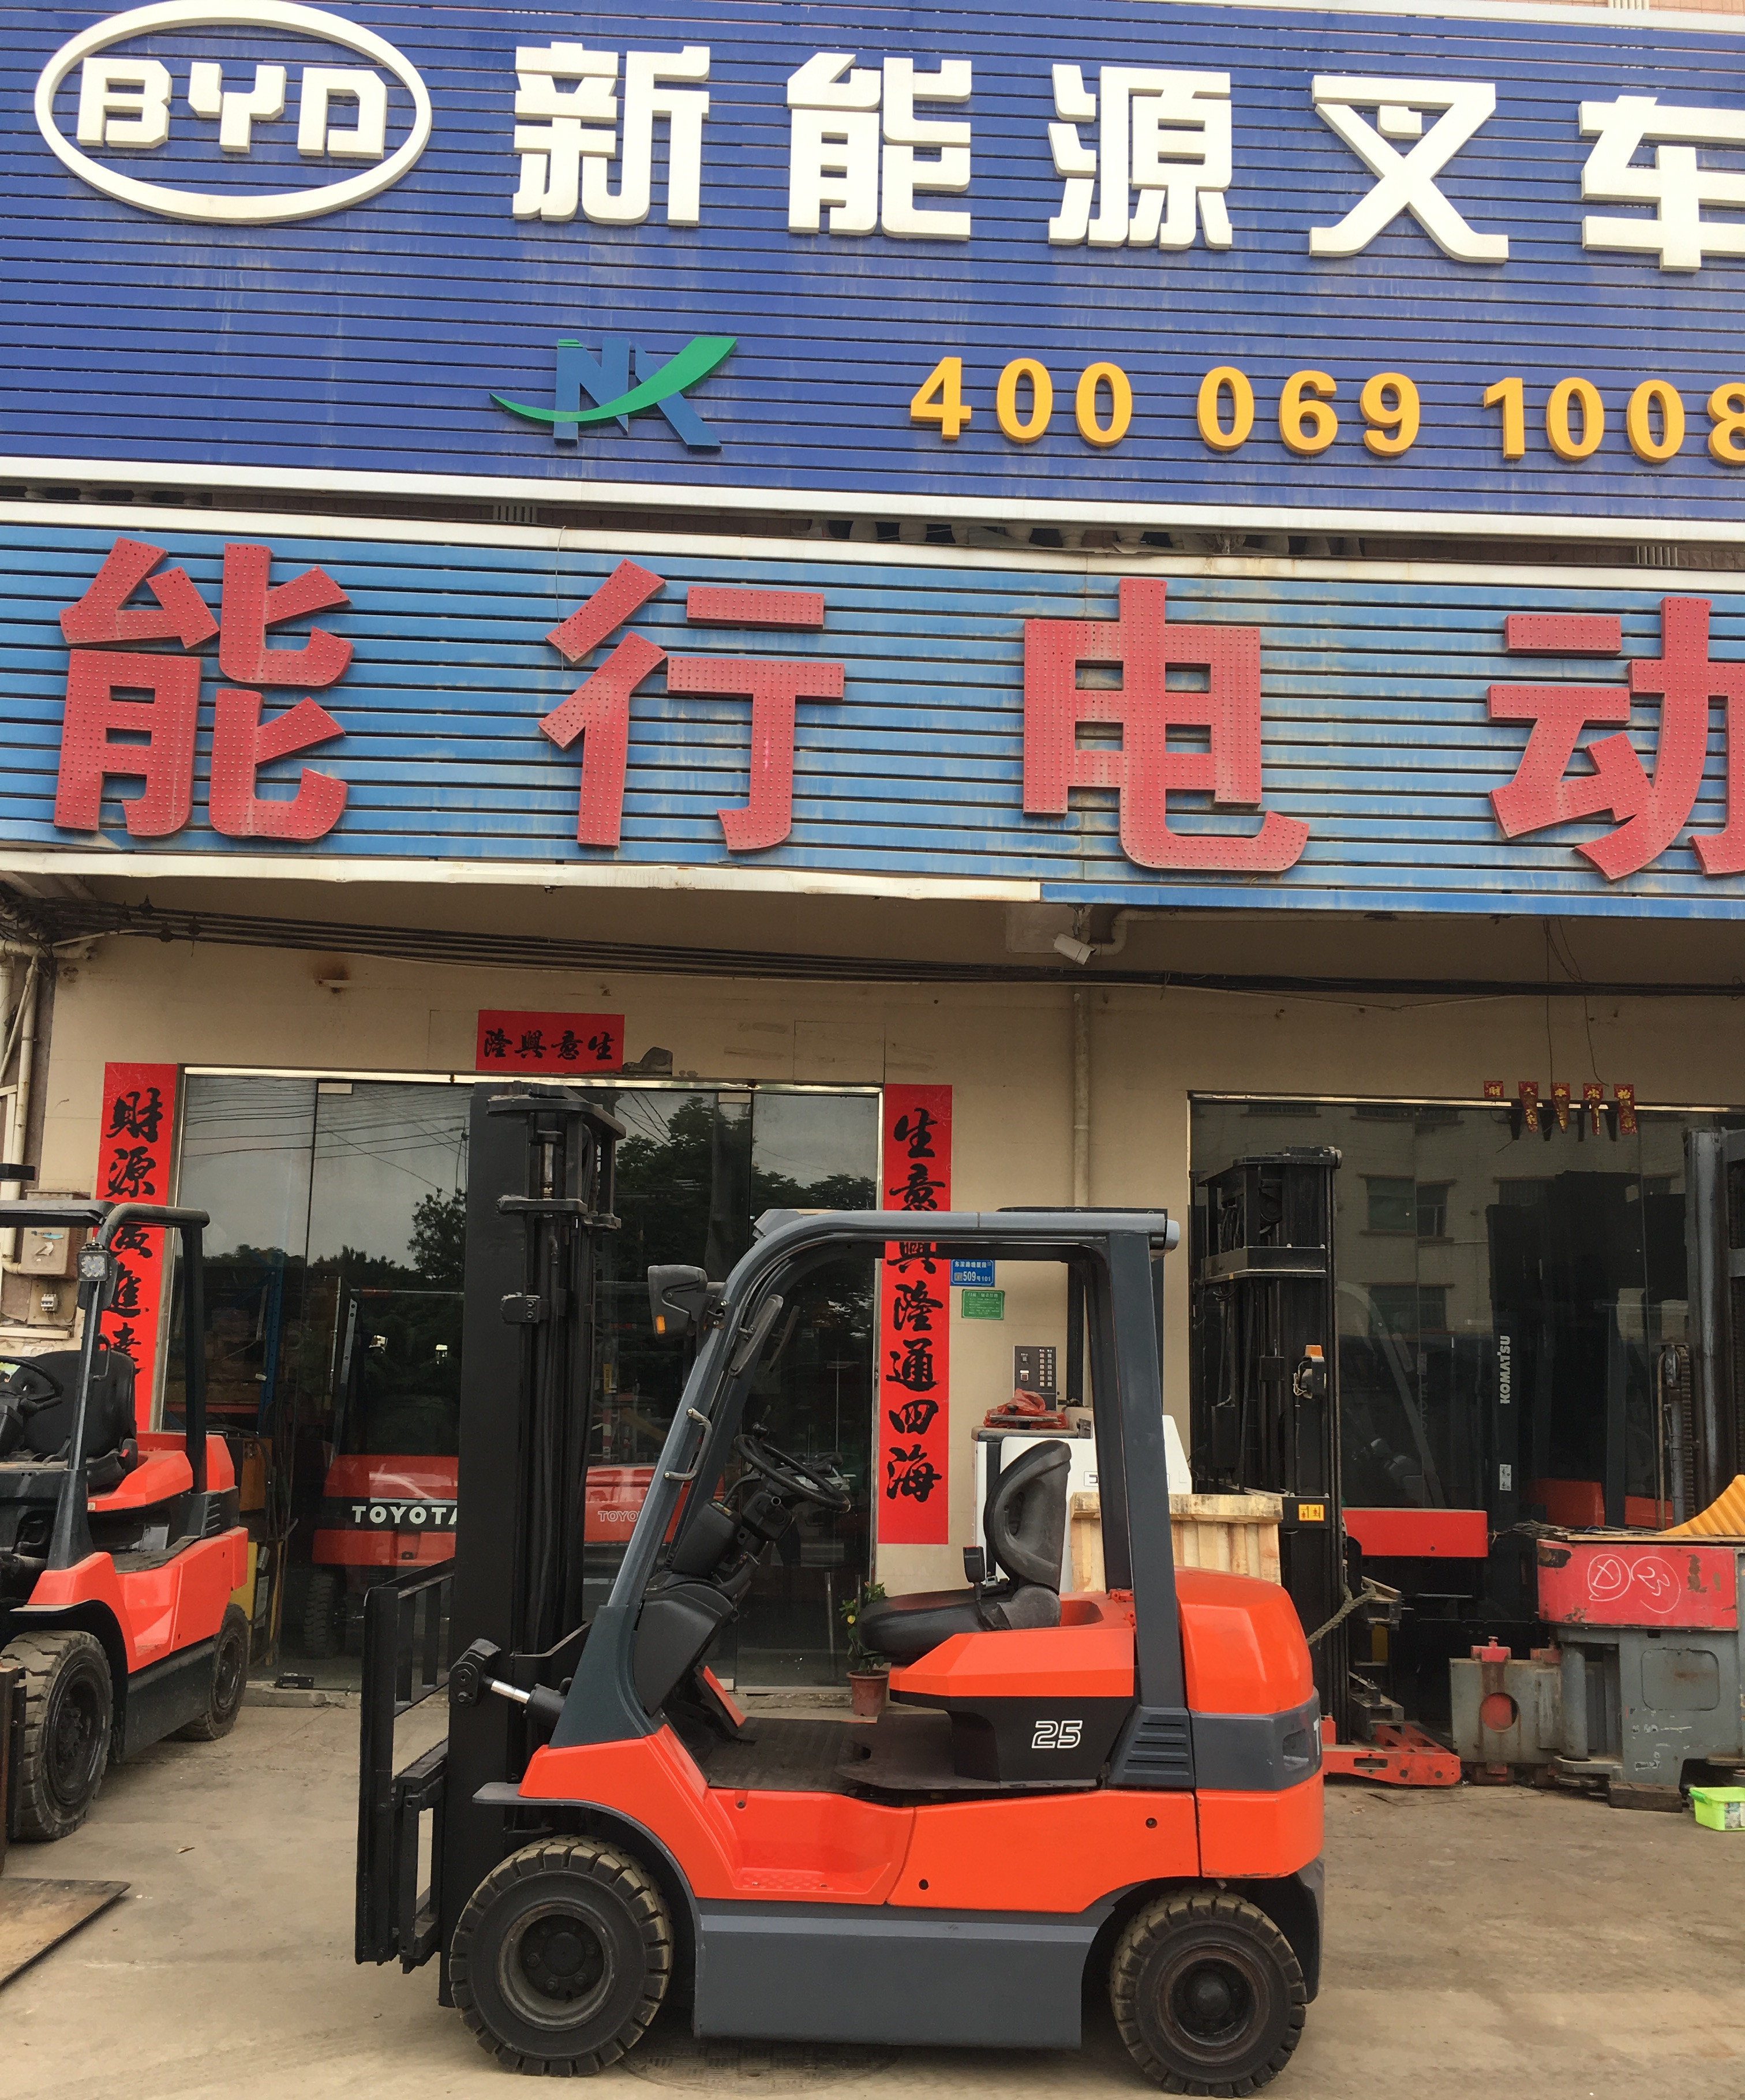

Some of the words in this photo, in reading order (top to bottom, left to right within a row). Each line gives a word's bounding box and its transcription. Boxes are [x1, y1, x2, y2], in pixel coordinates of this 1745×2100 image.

[76, 57, 388, 160] BYD
[512, 42, 1745, 273] 新能源叉车
[910, 356, 1133, 448] 400
[1197, 365, 1420, 457] 069
[1482, 376, 1745, 466] 1008
[54, 537, 1745, 882] 能行电动
[1497, 1335, 1511, 1404] KOMATSU
[597, 1510, 640, 1522] TOYO
[1031, 1720, 1083, 1749] 25
